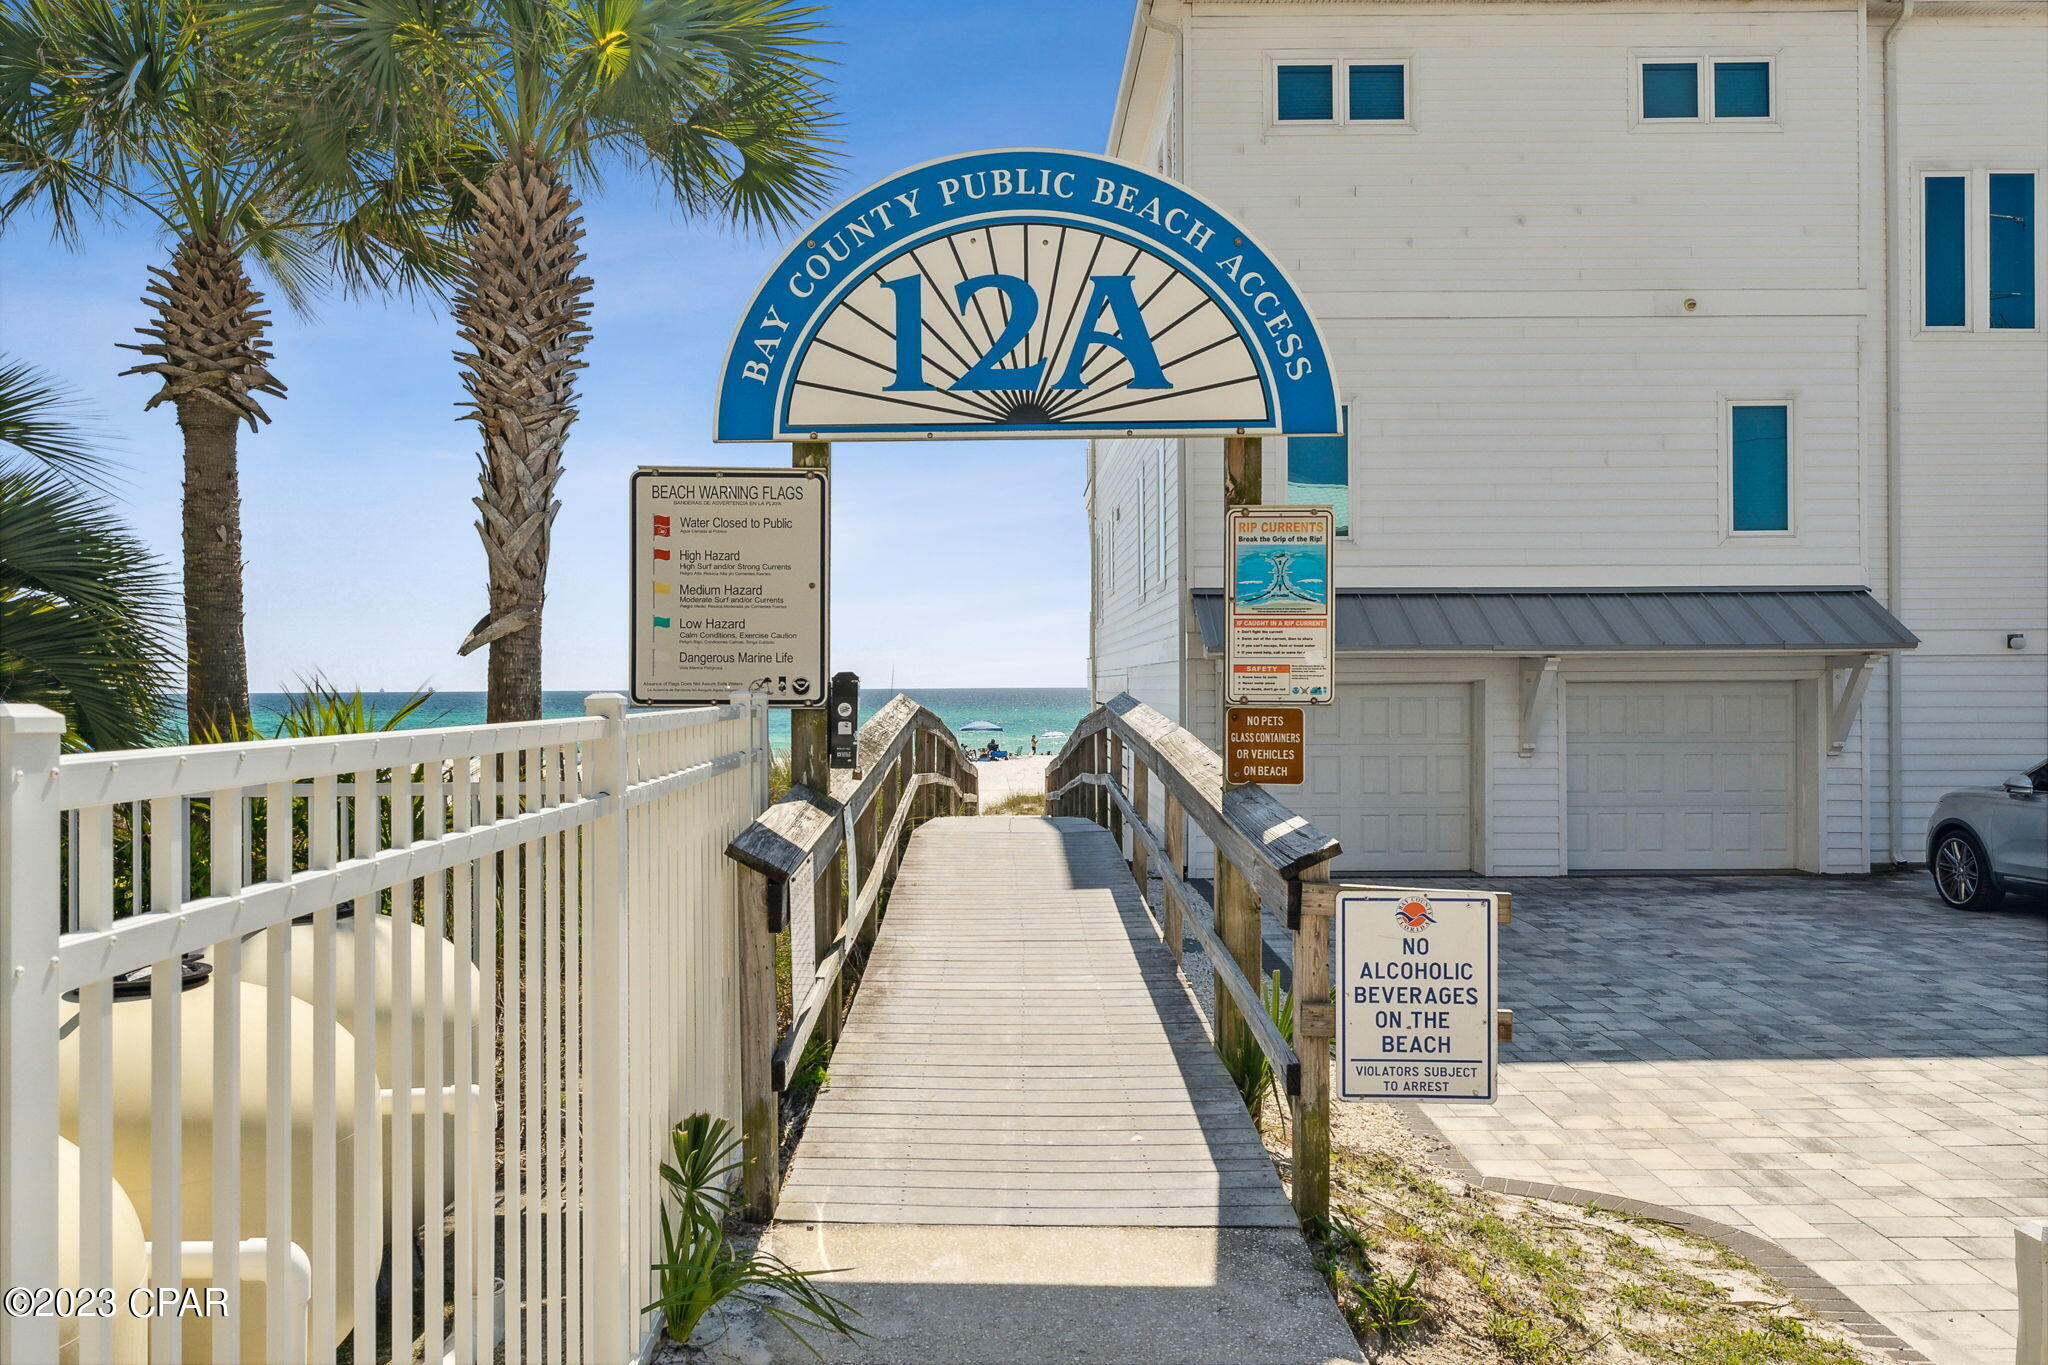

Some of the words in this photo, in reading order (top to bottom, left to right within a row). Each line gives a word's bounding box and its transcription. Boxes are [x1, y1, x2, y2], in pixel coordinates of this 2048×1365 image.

[741, 311, 790, 387] BAY
[788, 188, 921, 300] COUNTY
[941, 168, 1076, 207] PUBLIC
[1092, 177, 1216, 254] BEACH
[1215, 252, 1313, 382] ACCESS
[880, 274, 1174, 393] 12A
[652, 485, 695, 499] BEACH
[699, 485, 758, 500] WARNING
[762, 486, 804, 500] FLAGS
[680, 517, 709, 529] Water
[712, 517, 748, 529] Closed
[750, 518, 760, 529] to
[763, 517, 793, 529] Public
[1239, 522, 1257, 532] RIP
[1261, 522, 1324, 533] CURRENTS
[680, 550, 701, 563] High
[704, 550, 740, 561] Hazard
[680, 563, 696, 571] High
[738, 563, 760, 572] Strong
[680, 585, 720, 596] Medium
[724, 585, 762, 596] Hazard
[680, 618, 701, 629] Low
[706, 618, 746, 629] Hazard
[680, 652, 735, 665] Dangerous
[738, 652, 772, 663] Marine
[776, 652, 794, 663] Life
[1247, 716, 1259, 726] NO
[1262, 716, 1284, 726] PETS
[1231, 733, 1254, 742] GLASS
[1256, 733, 1301, 743] CONTAINERS
[1237, 749, 1249, 759] OR
[1252, 750, 1295, 760] VEHICLES
[1244, 766, 1256, 776] ON
[1258, 766, 1288, 776] BEACH
[1399, 899, 1409, 910] BAY
[1410, 898, 1432, 915] COUNTY
[1397, 917, 1430, 931] FLORIDA
[1403, 938, 1429, 955] NO
[1360, 962, 1473, 980] ALCOHOLIC
[1355, 987, 1478, 1005] BEVERAGES
[1376, 1011, 1401, 1028] ON
[1411, 1011, 1450, 1029] THE
[1382, 1036, 1451, 1053] BEACH
[1356, 1066, 1419, 1076] VIOLATORS
[1424, 1067, 1478, 1078] SUBJECT
[1384, 1081, 1398, 1091] TO
[1403, 1081, 1449, 1092] ARREST
